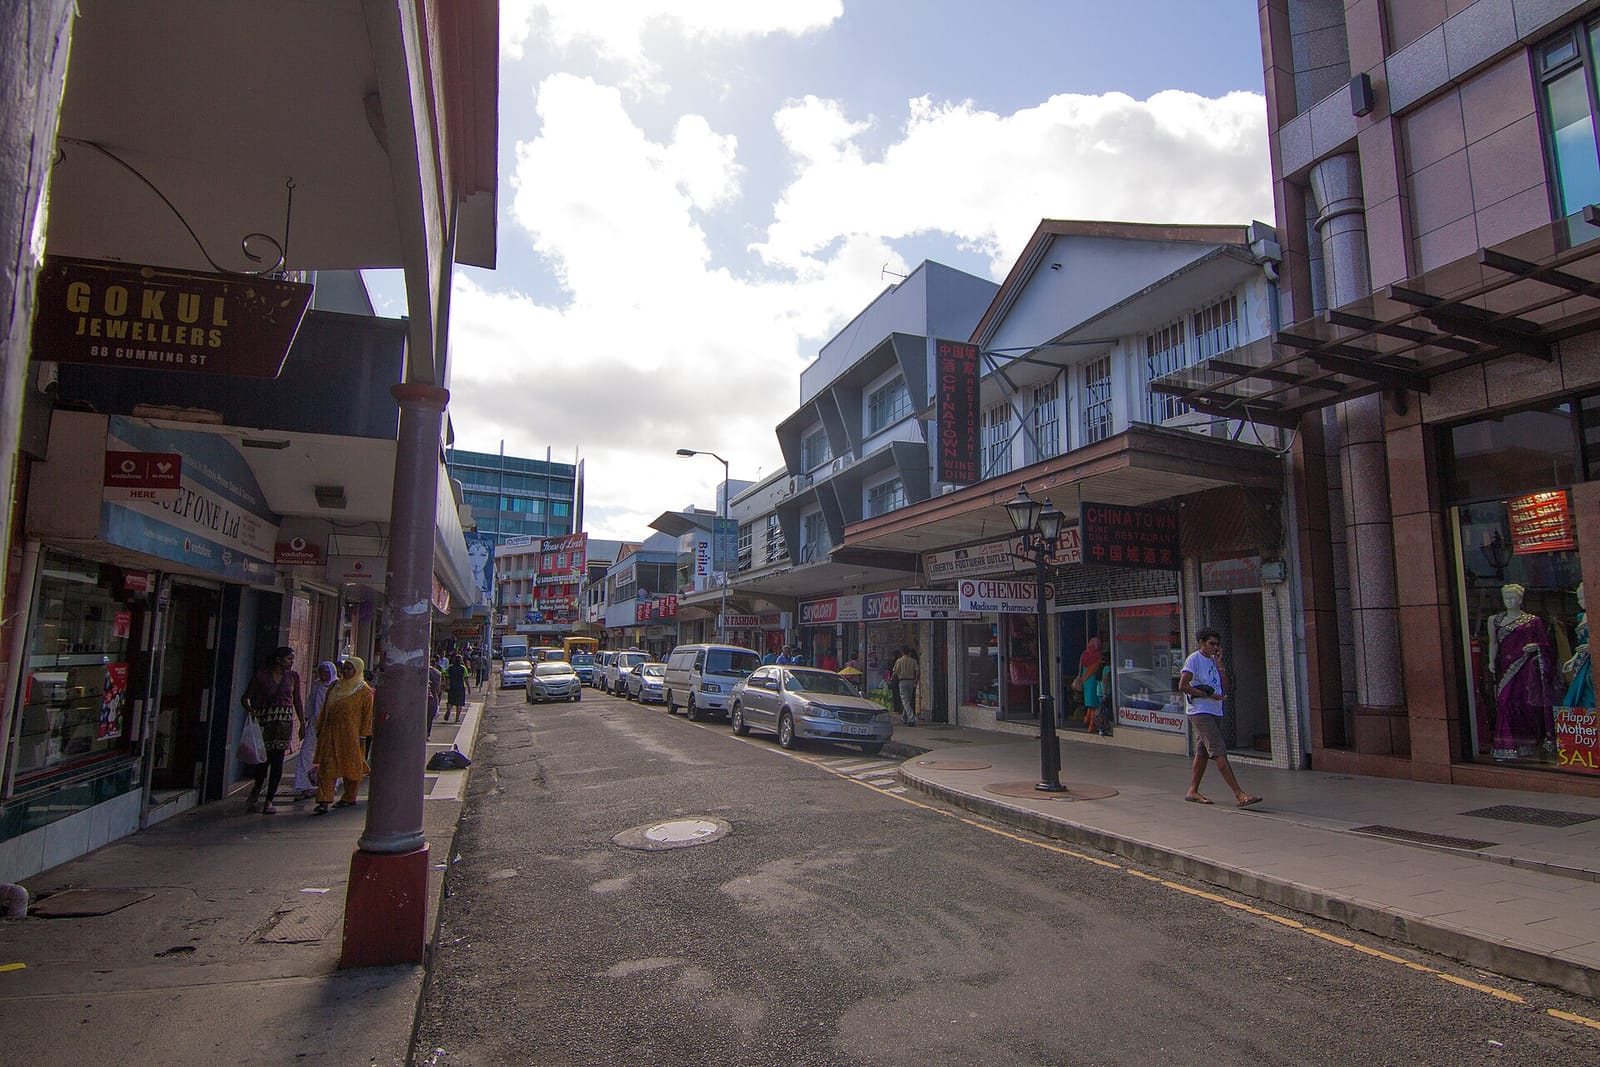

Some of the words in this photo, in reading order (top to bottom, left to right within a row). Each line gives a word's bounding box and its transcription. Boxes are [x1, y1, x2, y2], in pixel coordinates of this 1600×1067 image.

[66, 281, 228, 326] GOKUL
[75, 317, 222, 348] JEWELLERS
[115, 347, 184, 363] CUMMING
[190, 354, 207, 365] ST
[942, 375, 958, 458] CHINATOWN
[130, 490, 157, 499] HERE
[1511, 497, 1534, 511] SALE
[1534, 491, 1559, 503] SALE
[1087, 507, 1176, 529] CHINATOWN
[1512, 510, 1537, 523] SALE
[1537, 503, 1562, 517] SALE
[222, 510, 241, 540] Ltd
[1516, 522, 1541, 535] SALE
[1518, 535, 1542, 549] SALE
[280, 550, 313, 558] vodafone
[929, 561, 954, 573] LIBERTY
[954, 556, 986, 570] FOOTWEAR
[986, 552, 1010, 565] OUTLET
[901, 594, 926, 605] LIBERTY
[978, 581, 1039, 600] CHEMIST
[970, 601, 998, 611] Madison
[1002, 602, 1034, 613] Pharmacy
[730, 616, 759, 626] FASHION
[1124, 709, 1149, 724] Madison
[1149, 712, 1184, 730] Pharmacy
[1561, 711, 1596, 726] Happy
[1556, 723, 1598, 736] Mother
[1574, 735, 1597, 748] Day
